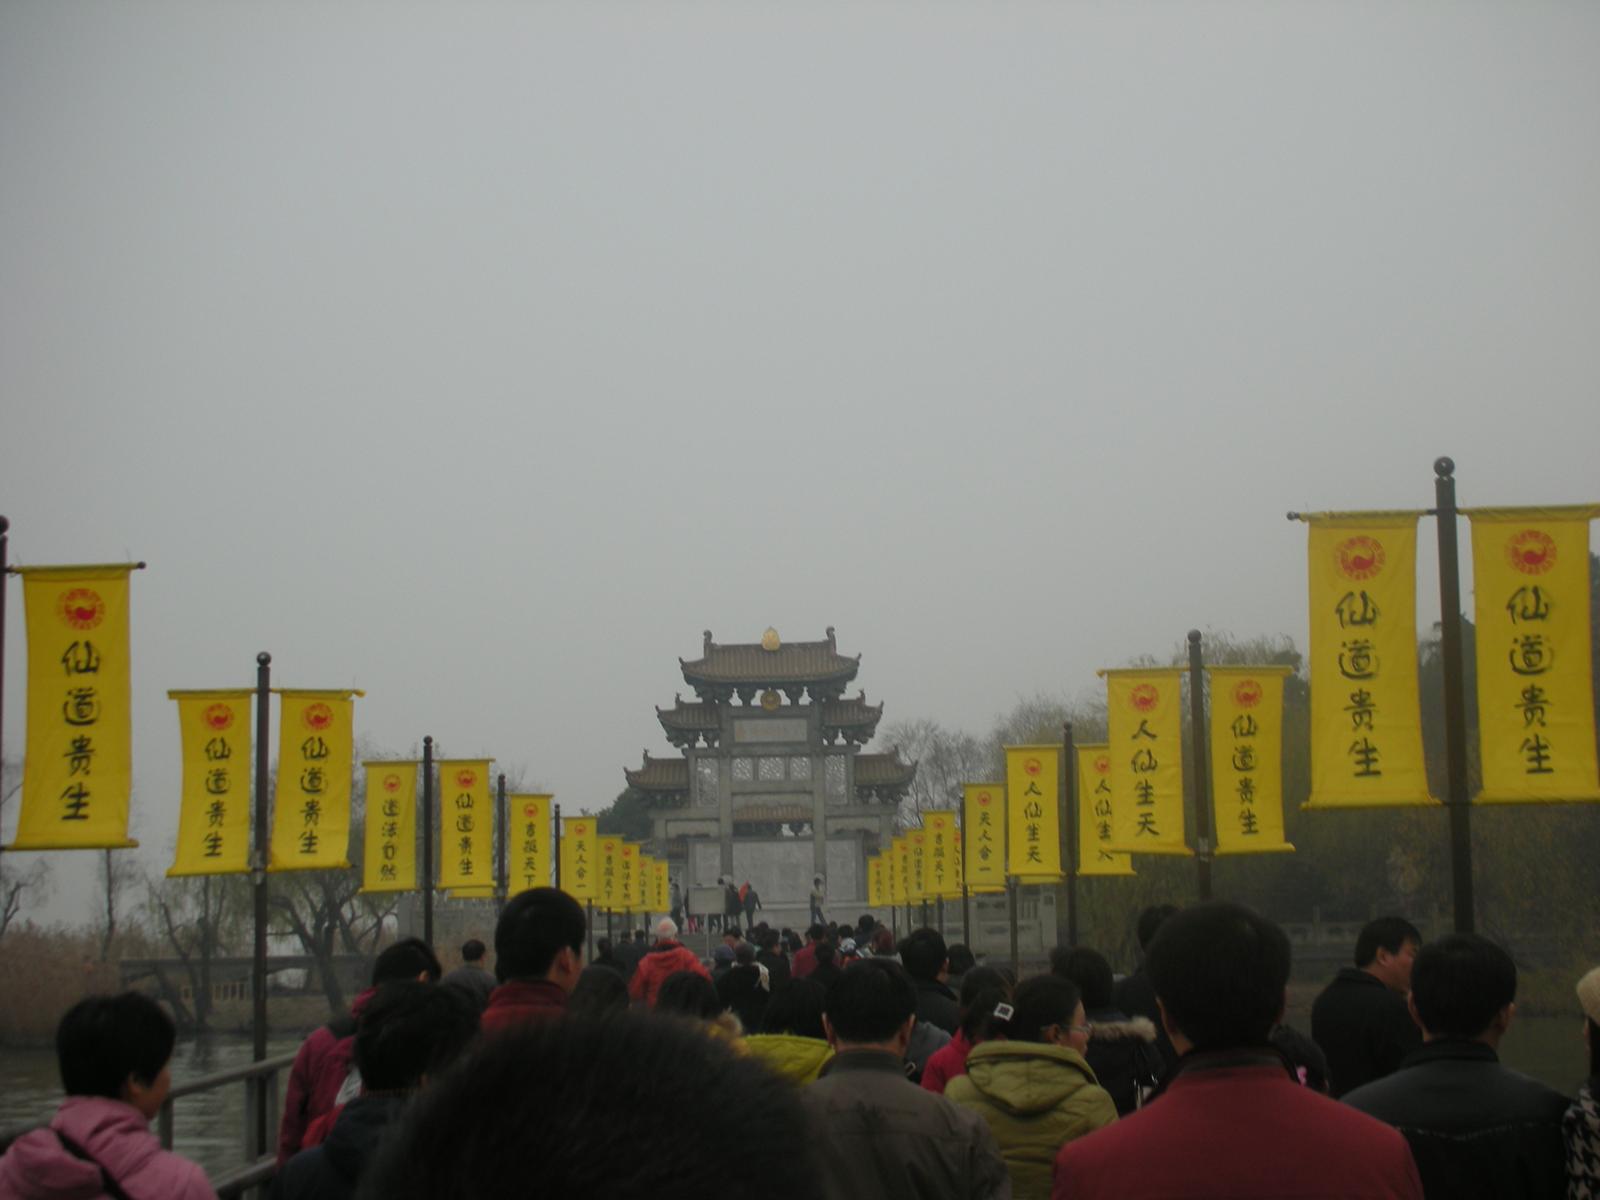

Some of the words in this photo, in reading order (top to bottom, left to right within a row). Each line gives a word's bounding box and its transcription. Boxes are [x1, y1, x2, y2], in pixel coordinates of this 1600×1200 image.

[61, 641, 100, 820] 仙道贵生
[1336, 591, 1382, 778] 仙道贵生
[1507, 586, 1554, 774] 仙道贵生
[204, 737, 231, 857] 仙道贵生
[300, 737, 330, 854] 仙道贵生
[1023, 781, 1043, 864] 人仙生天
[1130, 719, 1161, 836] 人仙生天
[1231, 714, 1260, 835] 仙道贵生
[455, 792, 475, 876] 仙道贵生
[978, 812, 993, 872] 天人合一
